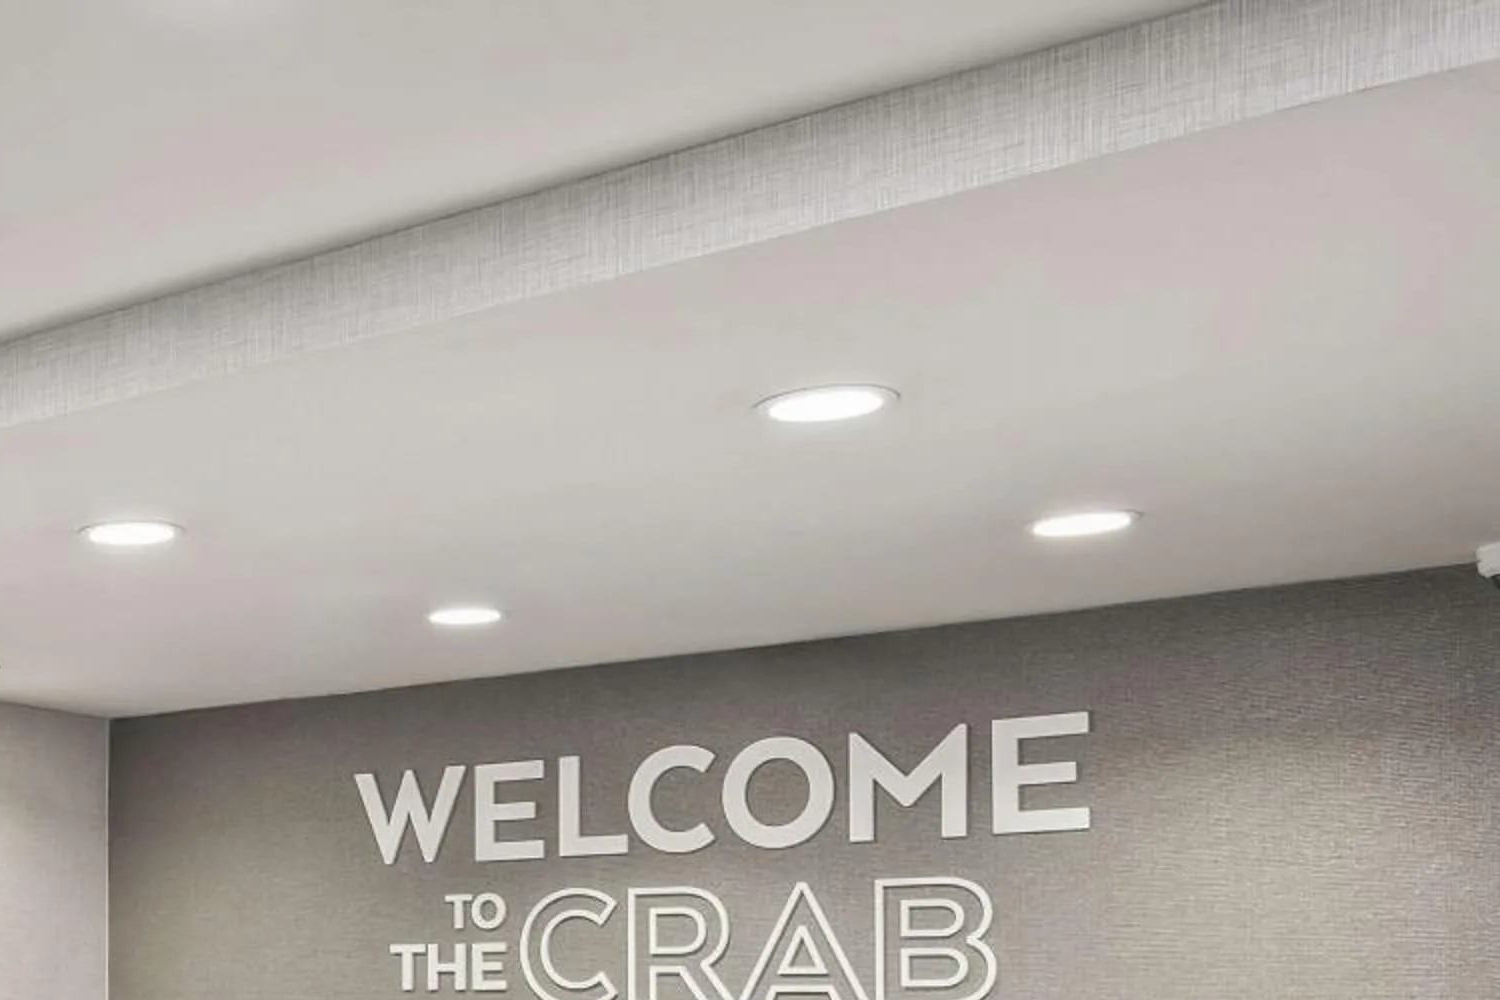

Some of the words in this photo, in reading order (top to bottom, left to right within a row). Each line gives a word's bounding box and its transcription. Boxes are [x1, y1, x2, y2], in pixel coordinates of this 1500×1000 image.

[355, 711, 1091, 865] WELCOME
[445, 893, 506, 930] TO
[389, 943, 507, 993] THE
